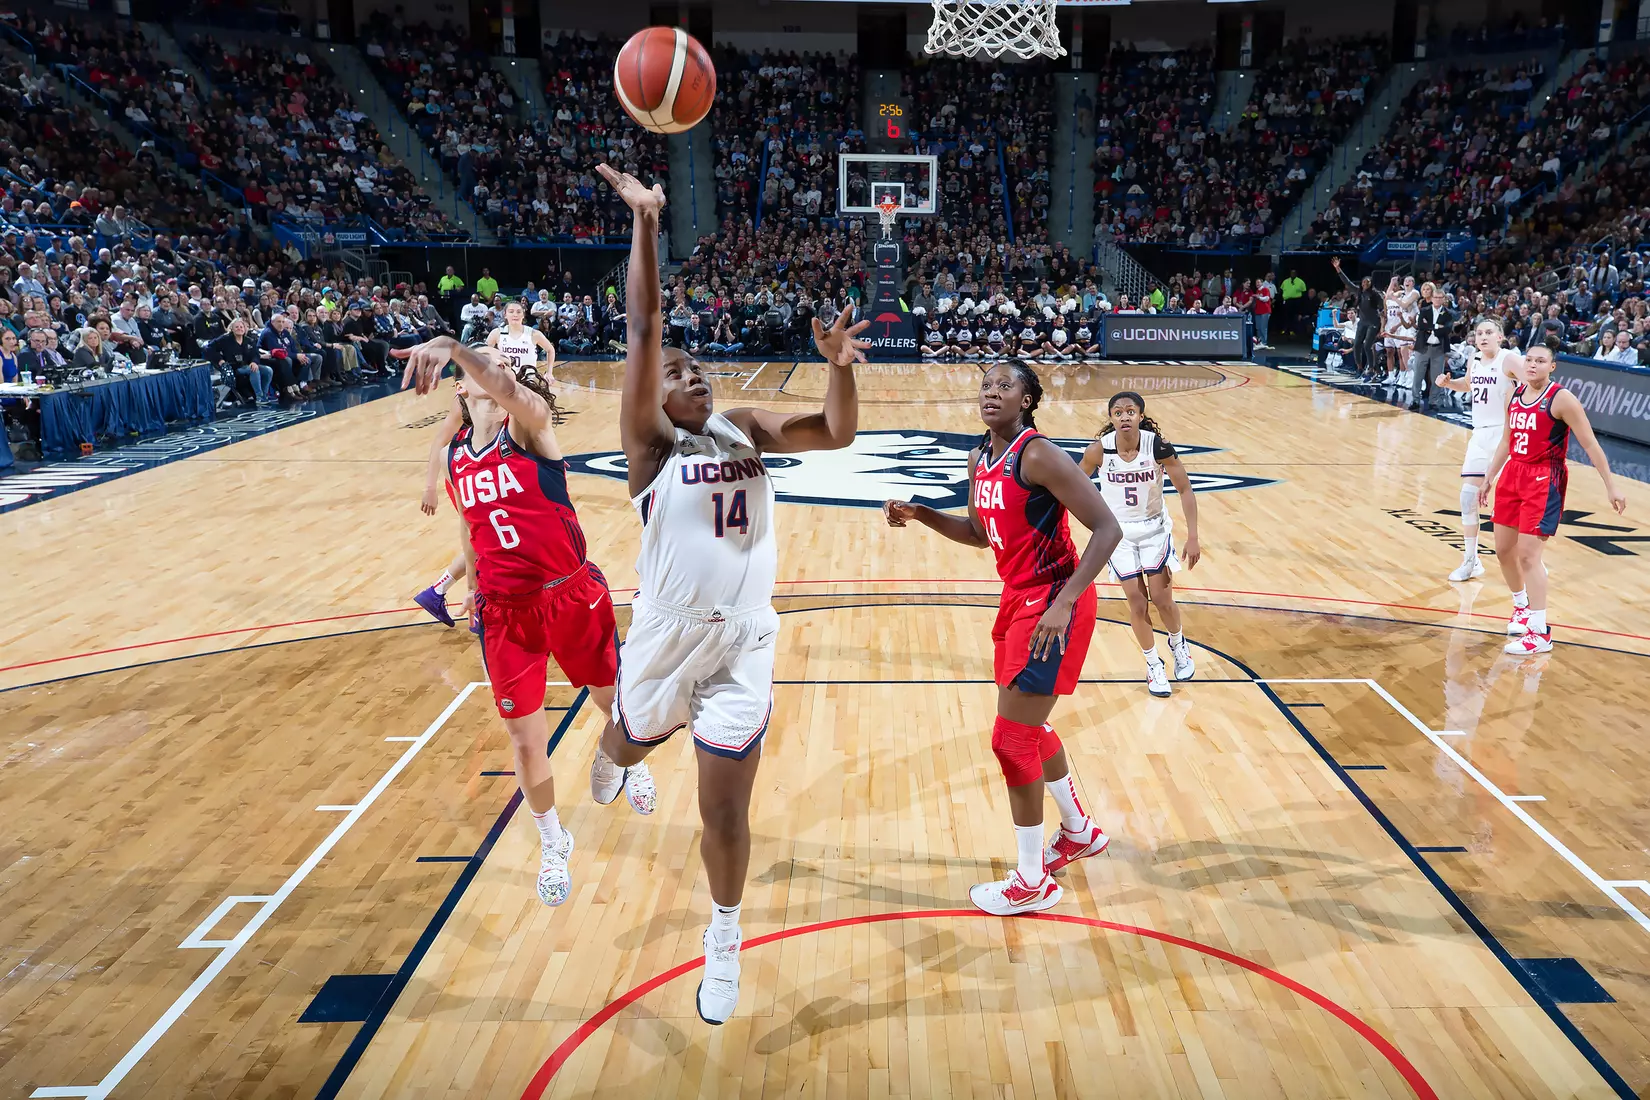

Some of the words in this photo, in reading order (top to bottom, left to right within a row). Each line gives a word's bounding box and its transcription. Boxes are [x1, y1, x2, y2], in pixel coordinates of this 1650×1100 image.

[879, 103, 903, 116] 2:56
[887, 118, 900, 139] 6
[350, 232, 365, 240] LIGHT
[502, 346, 529, 354] UCONN
[1473, 387, 1488, 404] 24
[1509, 412, 1537, 430] USA
[1513, 432, 1529, 455] 32
[681, 456, 766, 485] UCONN
[1106, 470, 1155, 484] UCONN
[458, 462, 525, 509] USA
[974, 479, 1006, 510] USA
[1124, 486, 1139, 507] 5
[711, 489, 749, 538] 14
[488, 508, 521, 550] 6
